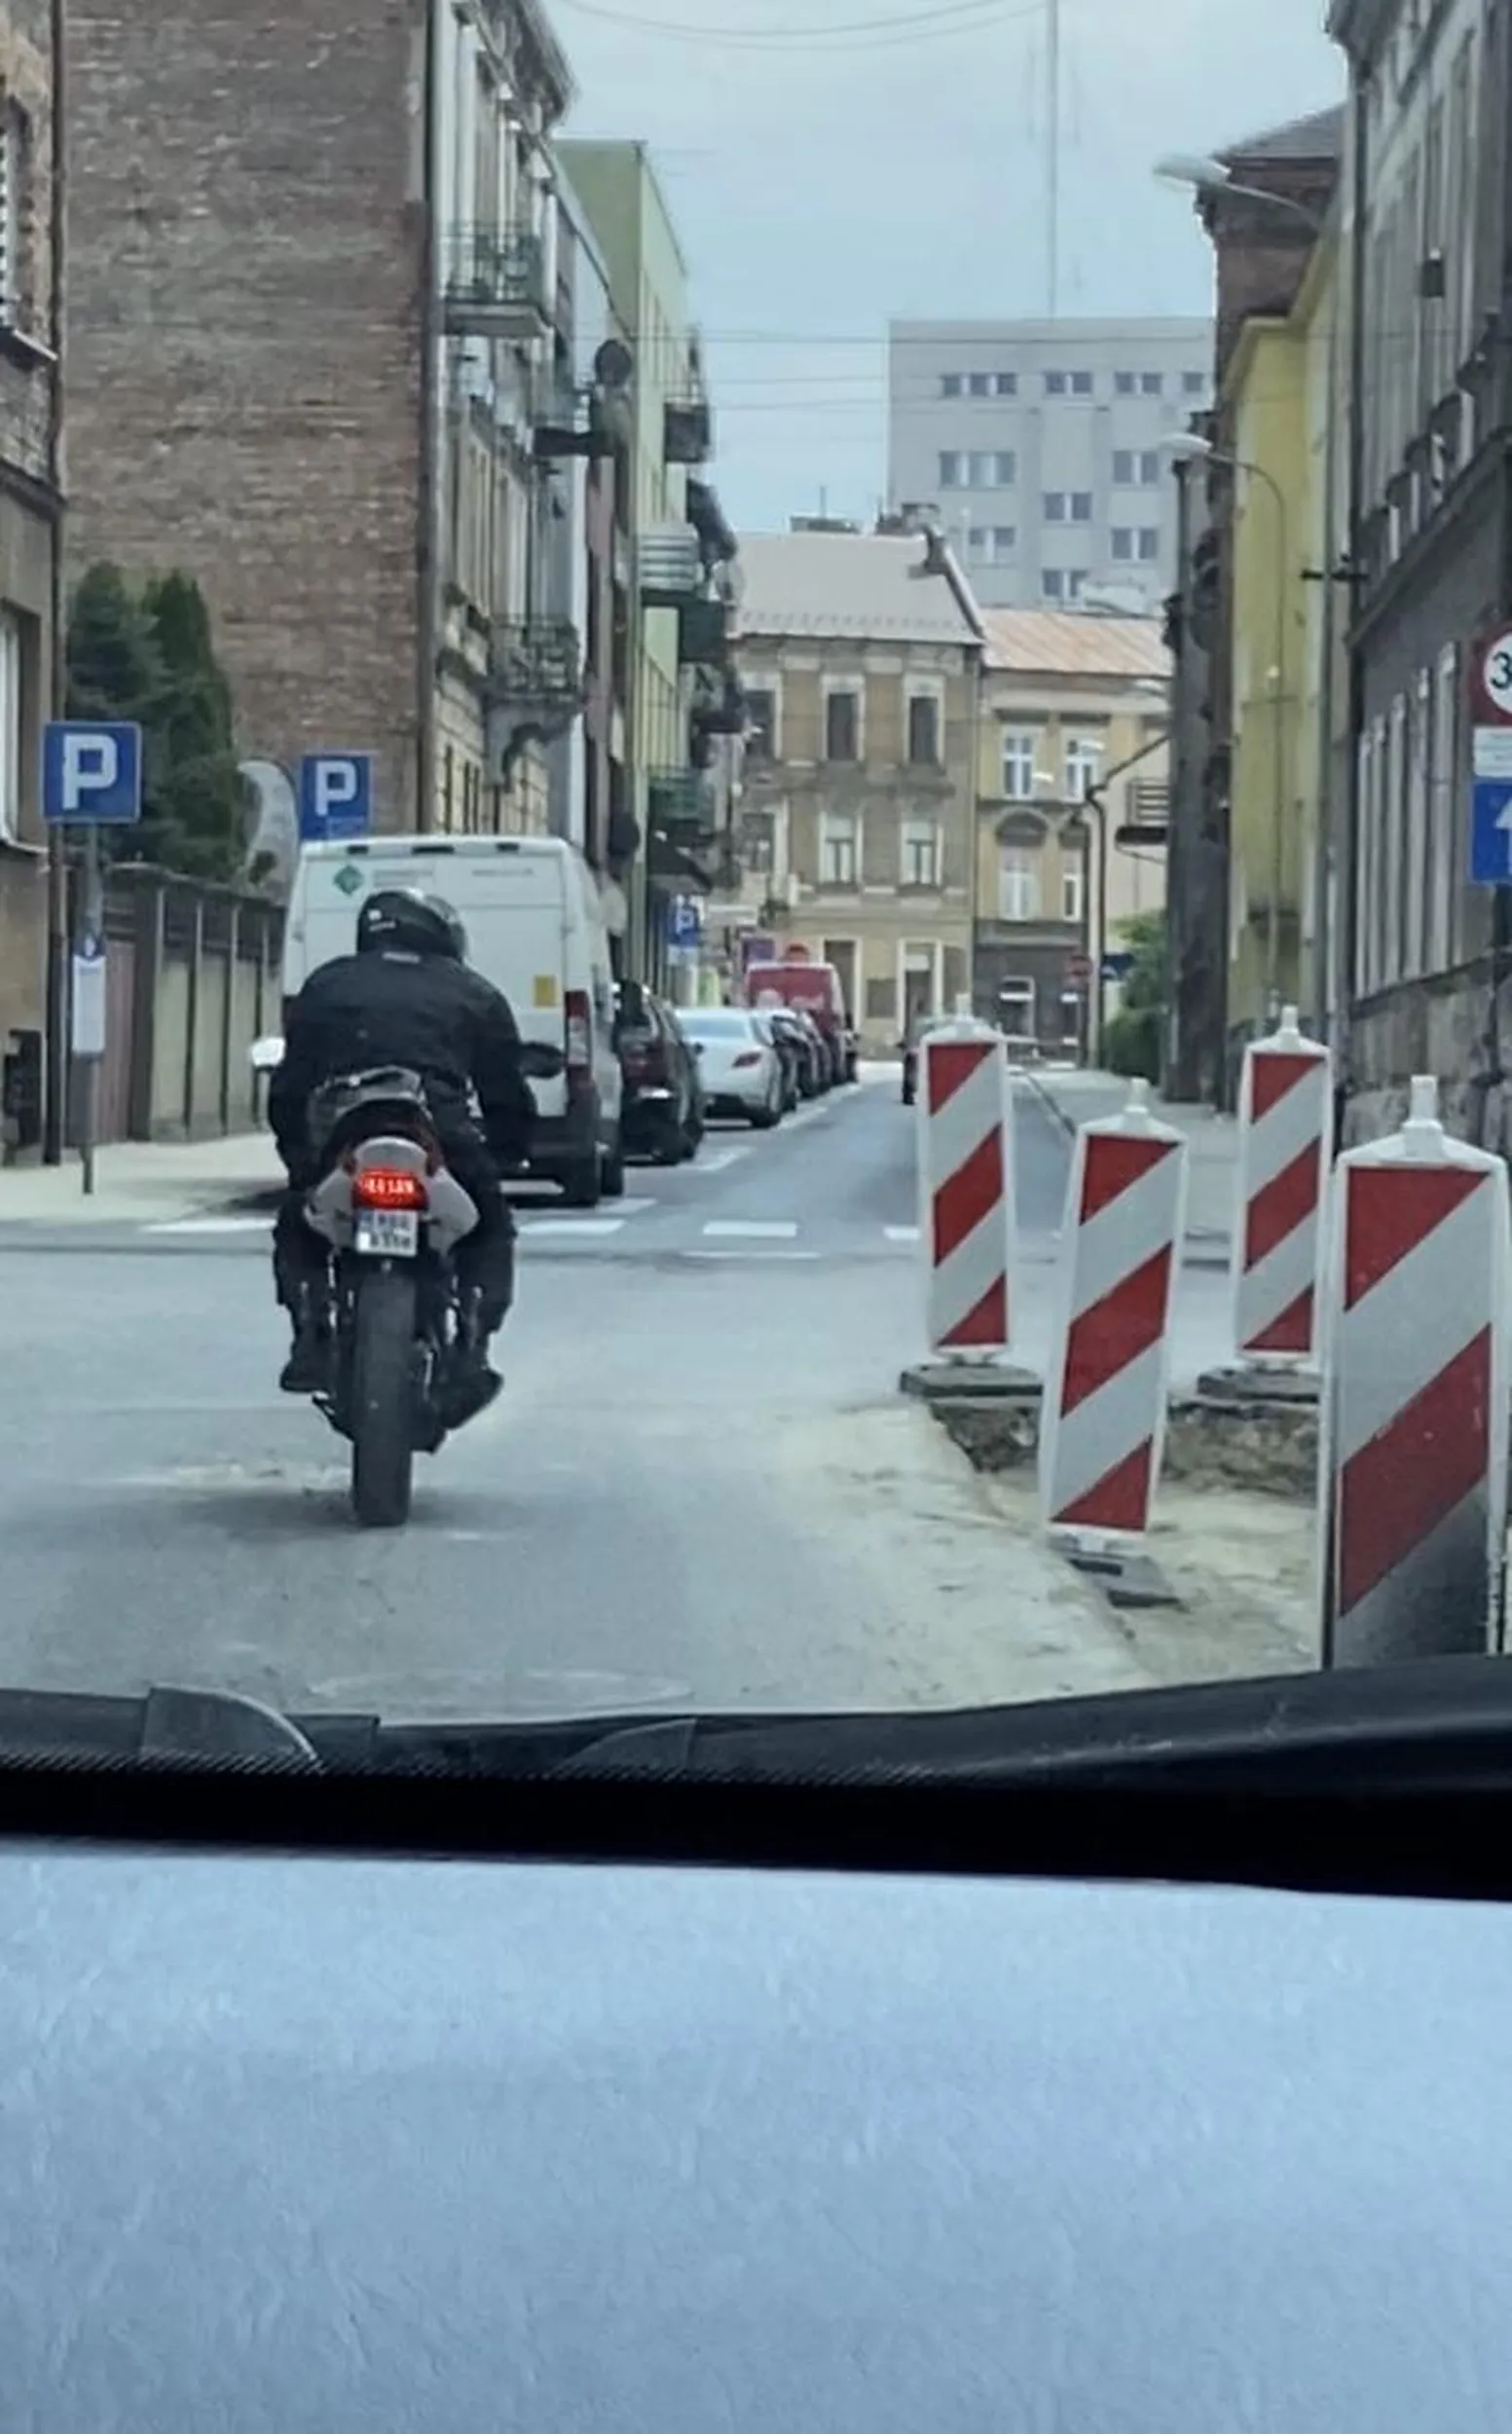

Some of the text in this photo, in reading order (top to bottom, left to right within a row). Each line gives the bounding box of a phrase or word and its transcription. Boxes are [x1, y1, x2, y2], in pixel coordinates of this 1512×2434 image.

[62, 733, 117, 810] P
[315, 760, 356, 816] P
[676, 908, 694, 935] P
